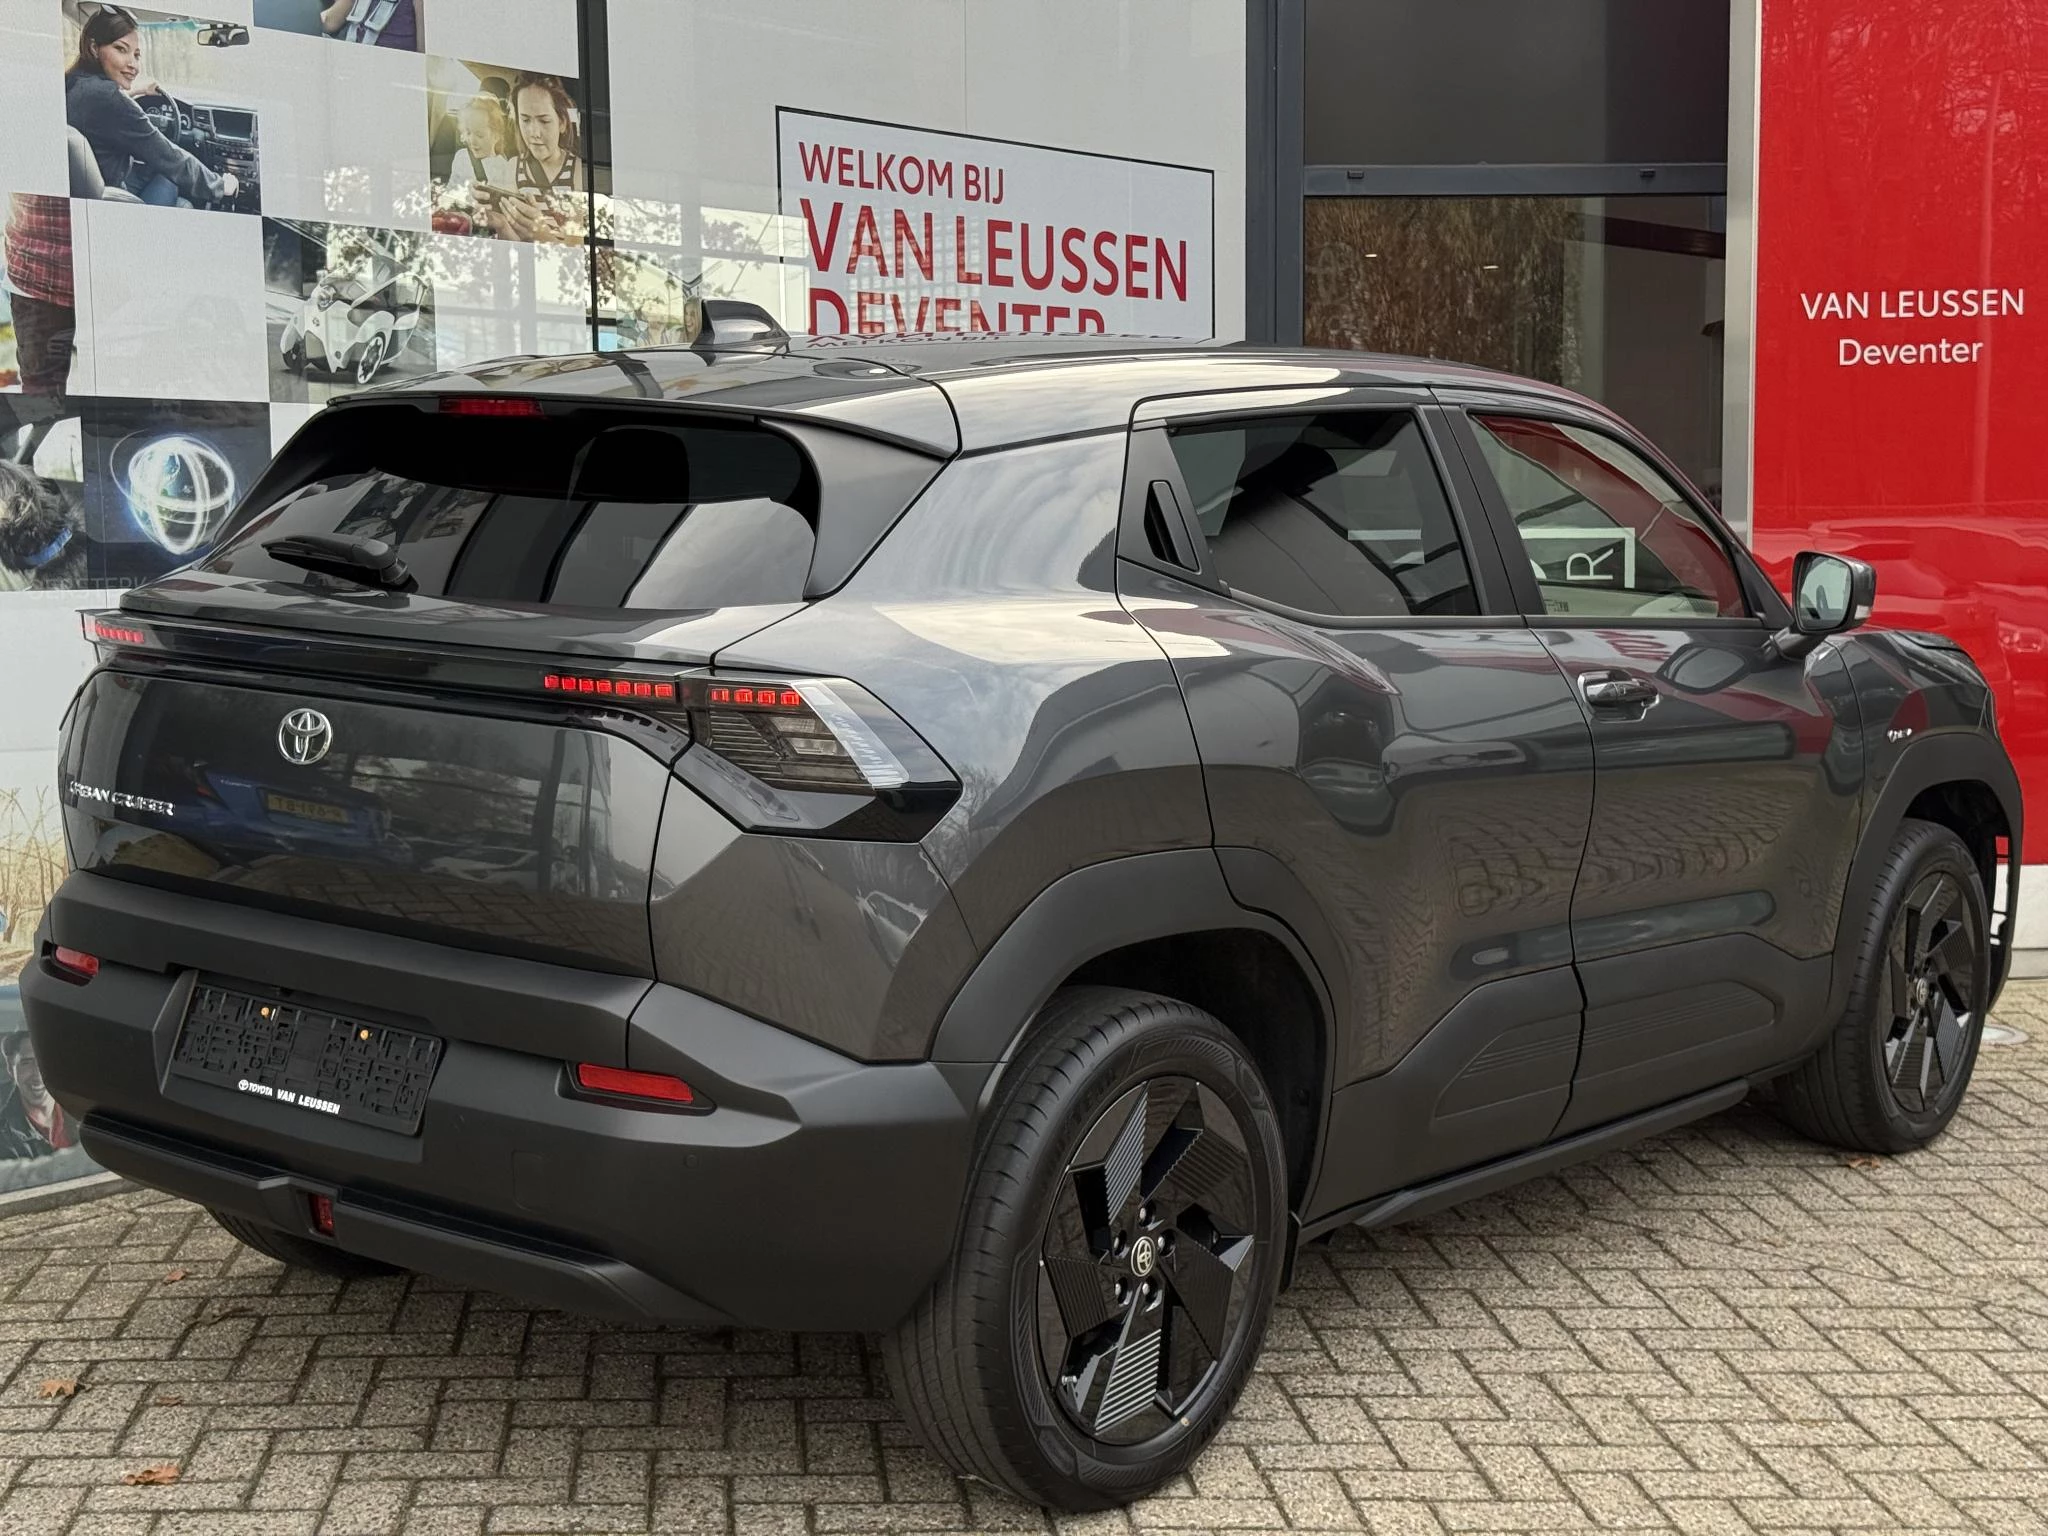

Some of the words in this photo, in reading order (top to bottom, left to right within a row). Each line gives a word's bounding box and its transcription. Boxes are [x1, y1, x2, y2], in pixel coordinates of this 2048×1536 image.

[798, 142, 953, 198] WELKOM
[965, 164, 1005, 205] BIJ
[800, 198, 933, 281] VAN
[956, 215, 1187, 302] LEUSSEN
[1800, 291, 1869, 320] VAN
[1880, 288, 2024, 319] LEUSSEN
[1839, 338, 1983, 366] Deventer
[248, 1082, 273, 1096] TOYOTA
[276, 1088, 297, 1103] VAN
[298, 1094, 341, 1115] LEUSSEN
